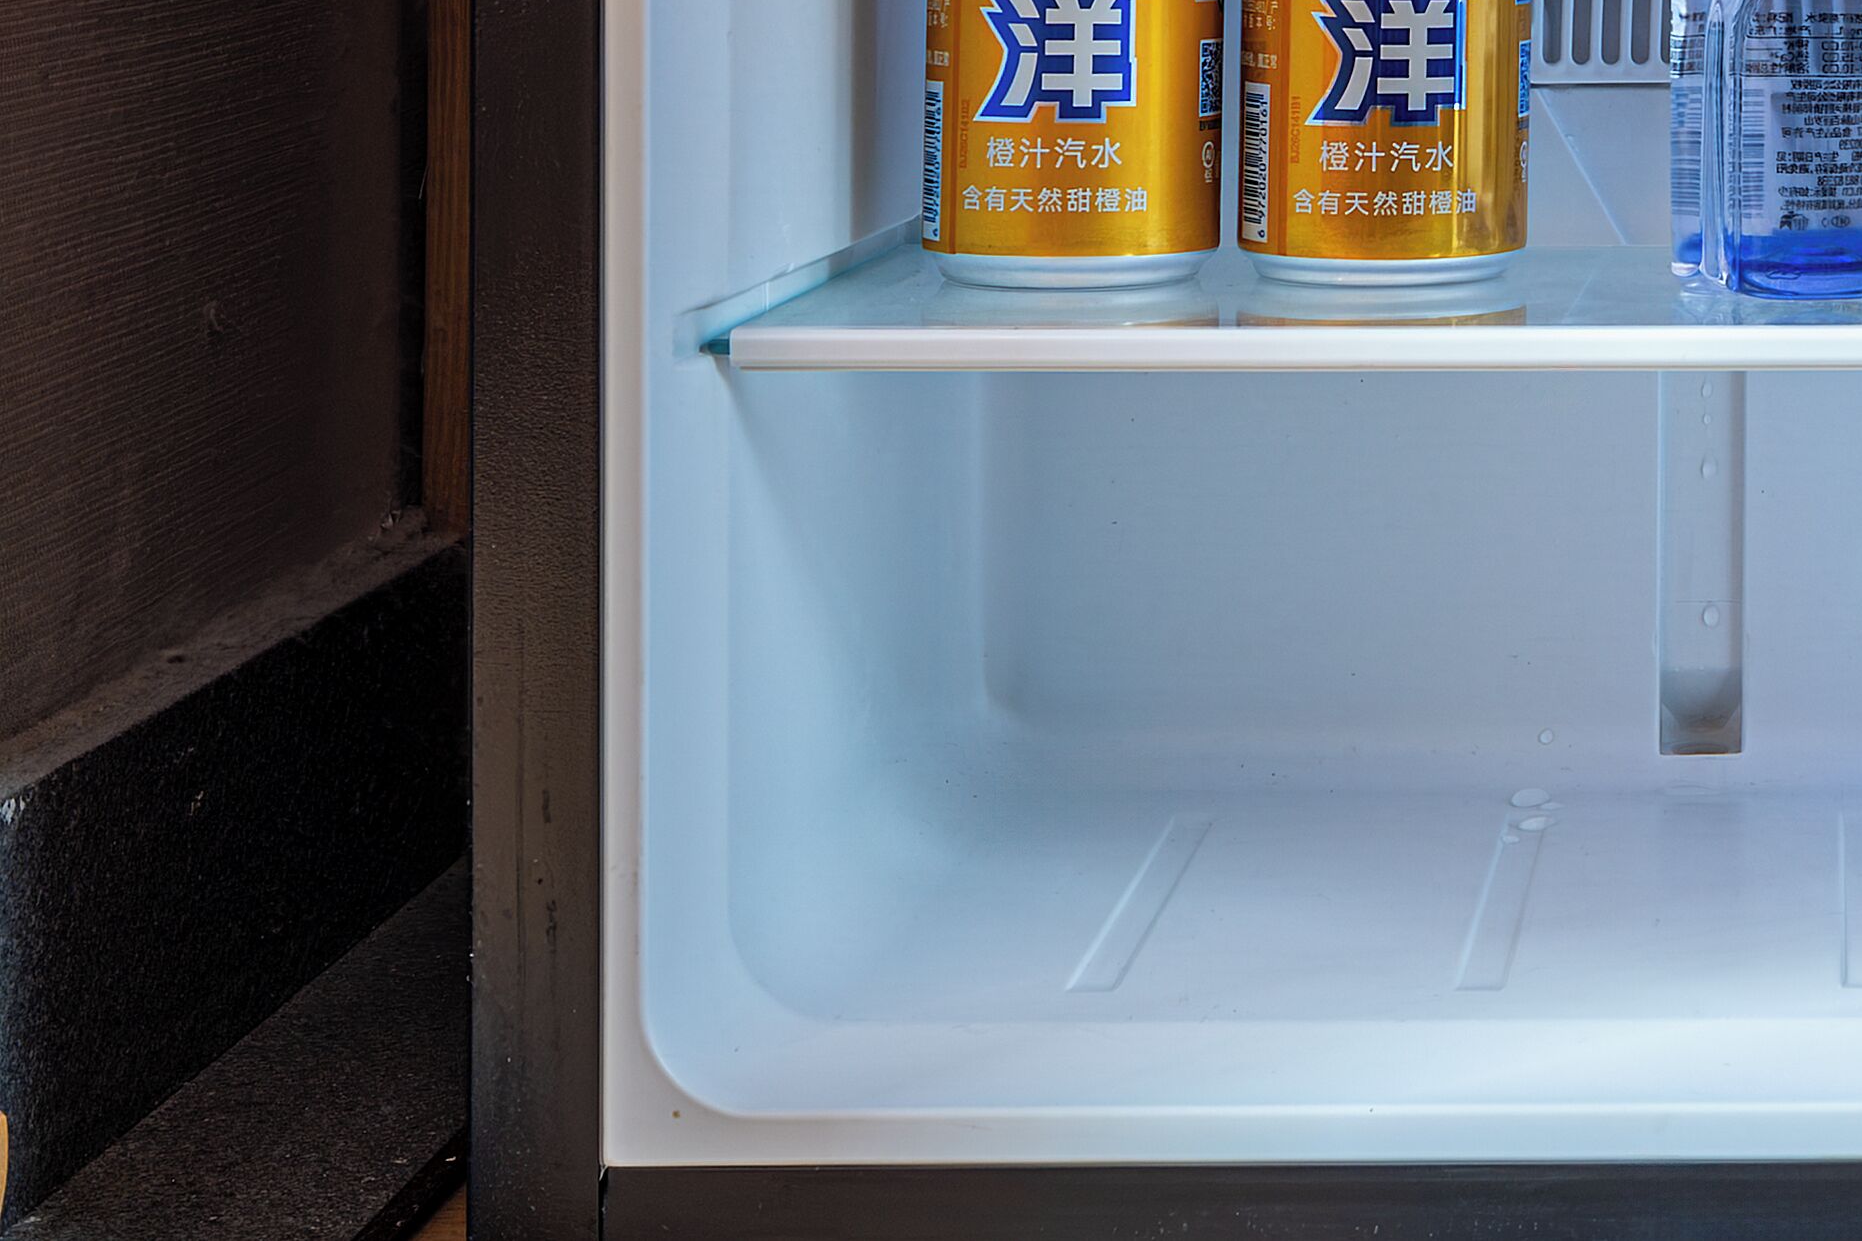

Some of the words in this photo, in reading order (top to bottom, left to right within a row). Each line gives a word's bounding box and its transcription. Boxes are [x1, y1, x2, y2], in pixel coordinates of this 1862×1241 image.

[986, 136, 1123, 169] 橙汁汽水
[1318, 140, 1454, 172] 橙汁汽水
[961, 184, 1149, 214] 含有天然甜橙油
[1292, 188, 1478, 216] 含有天然甜橙油
